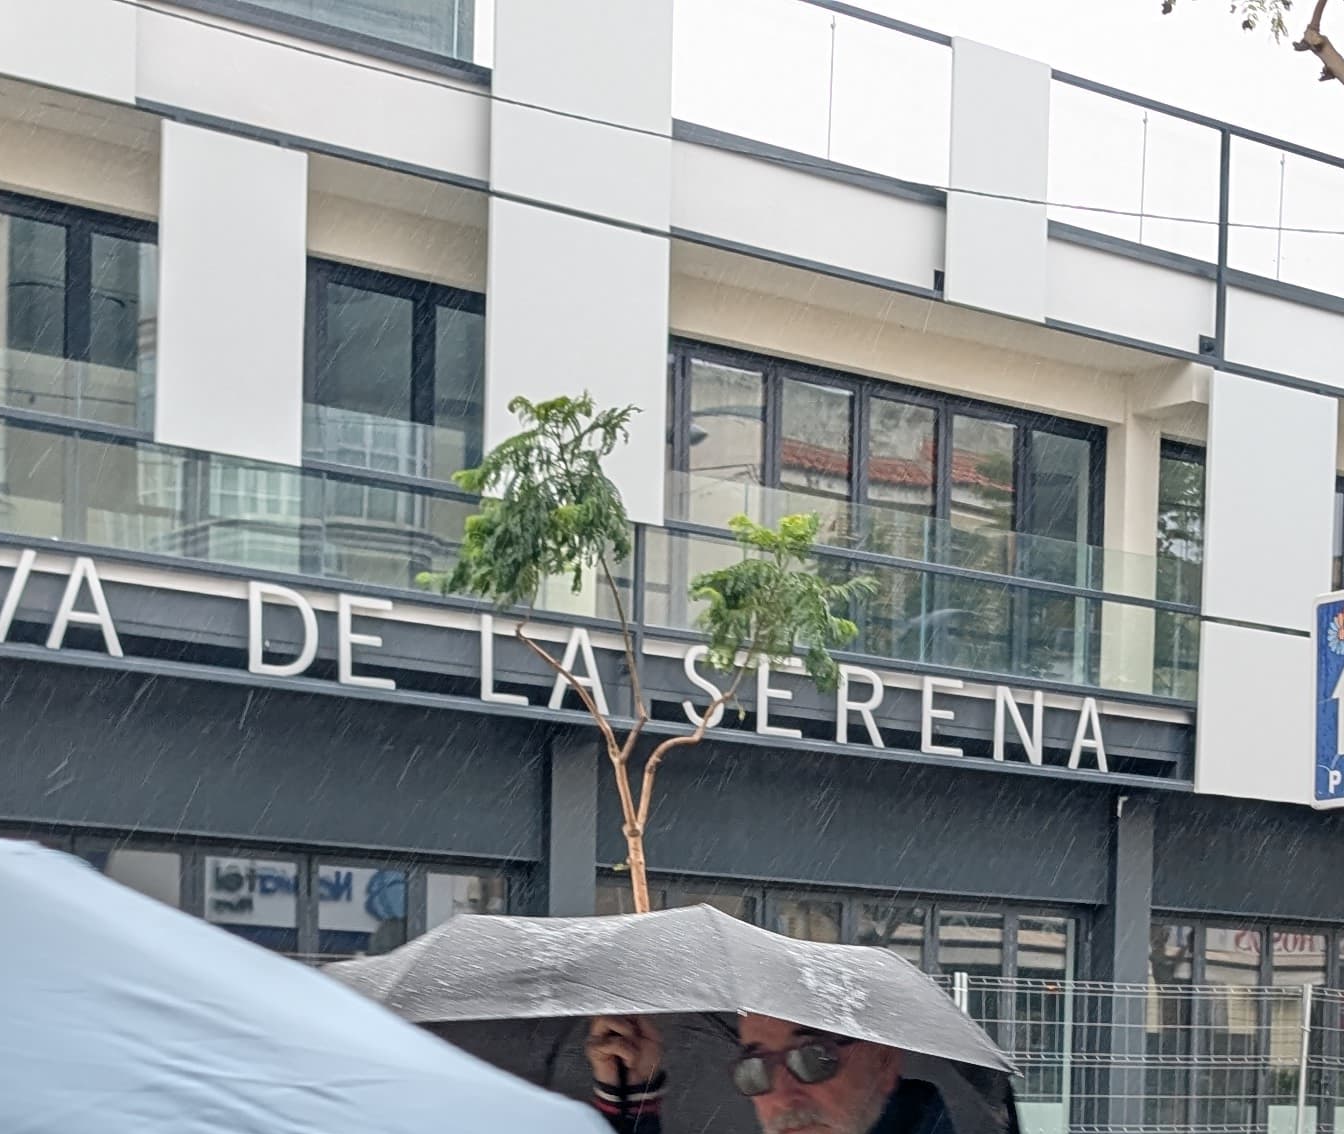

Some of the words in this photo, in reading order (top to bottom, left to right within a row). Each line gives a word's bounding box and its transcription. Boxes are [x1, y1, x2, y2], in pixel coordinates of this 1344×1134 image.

[247, 580, 396, 691] DE
[479, 613, 611, 717] LA
[682, 644, 1109, 773] SERENA
